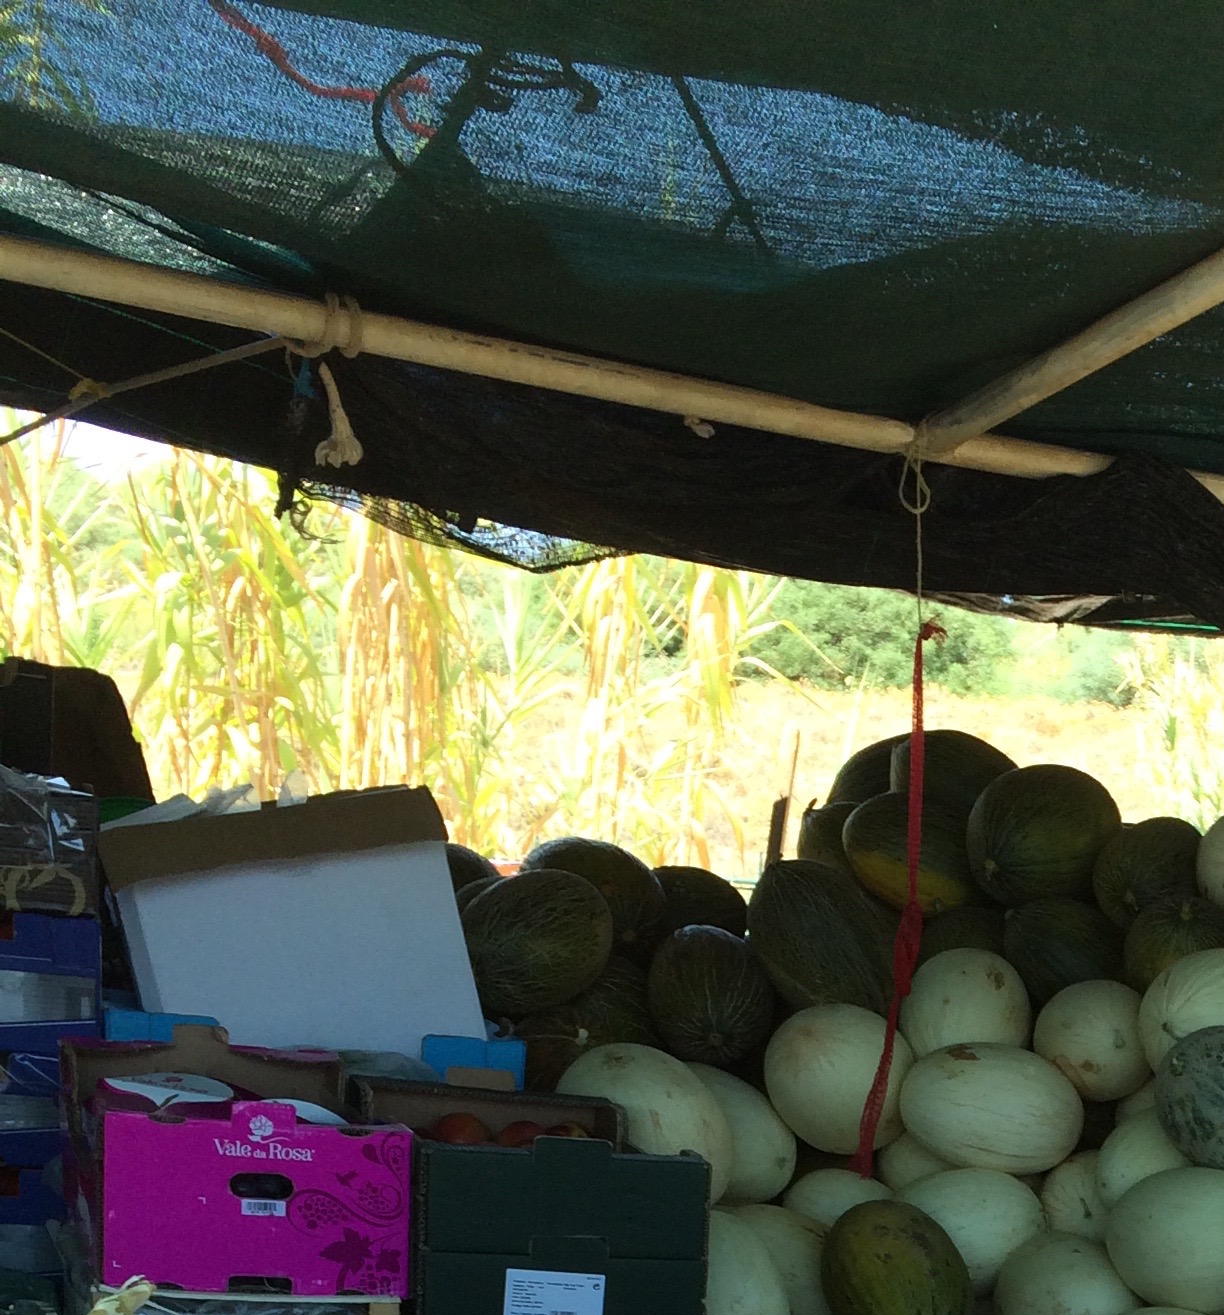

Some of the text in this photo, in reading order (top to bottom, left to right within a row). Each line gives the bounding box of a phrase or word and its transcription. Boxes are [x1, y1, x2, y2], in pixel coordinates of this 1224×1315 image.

[213, 1138, 314, 1162] Vale da Rosa
